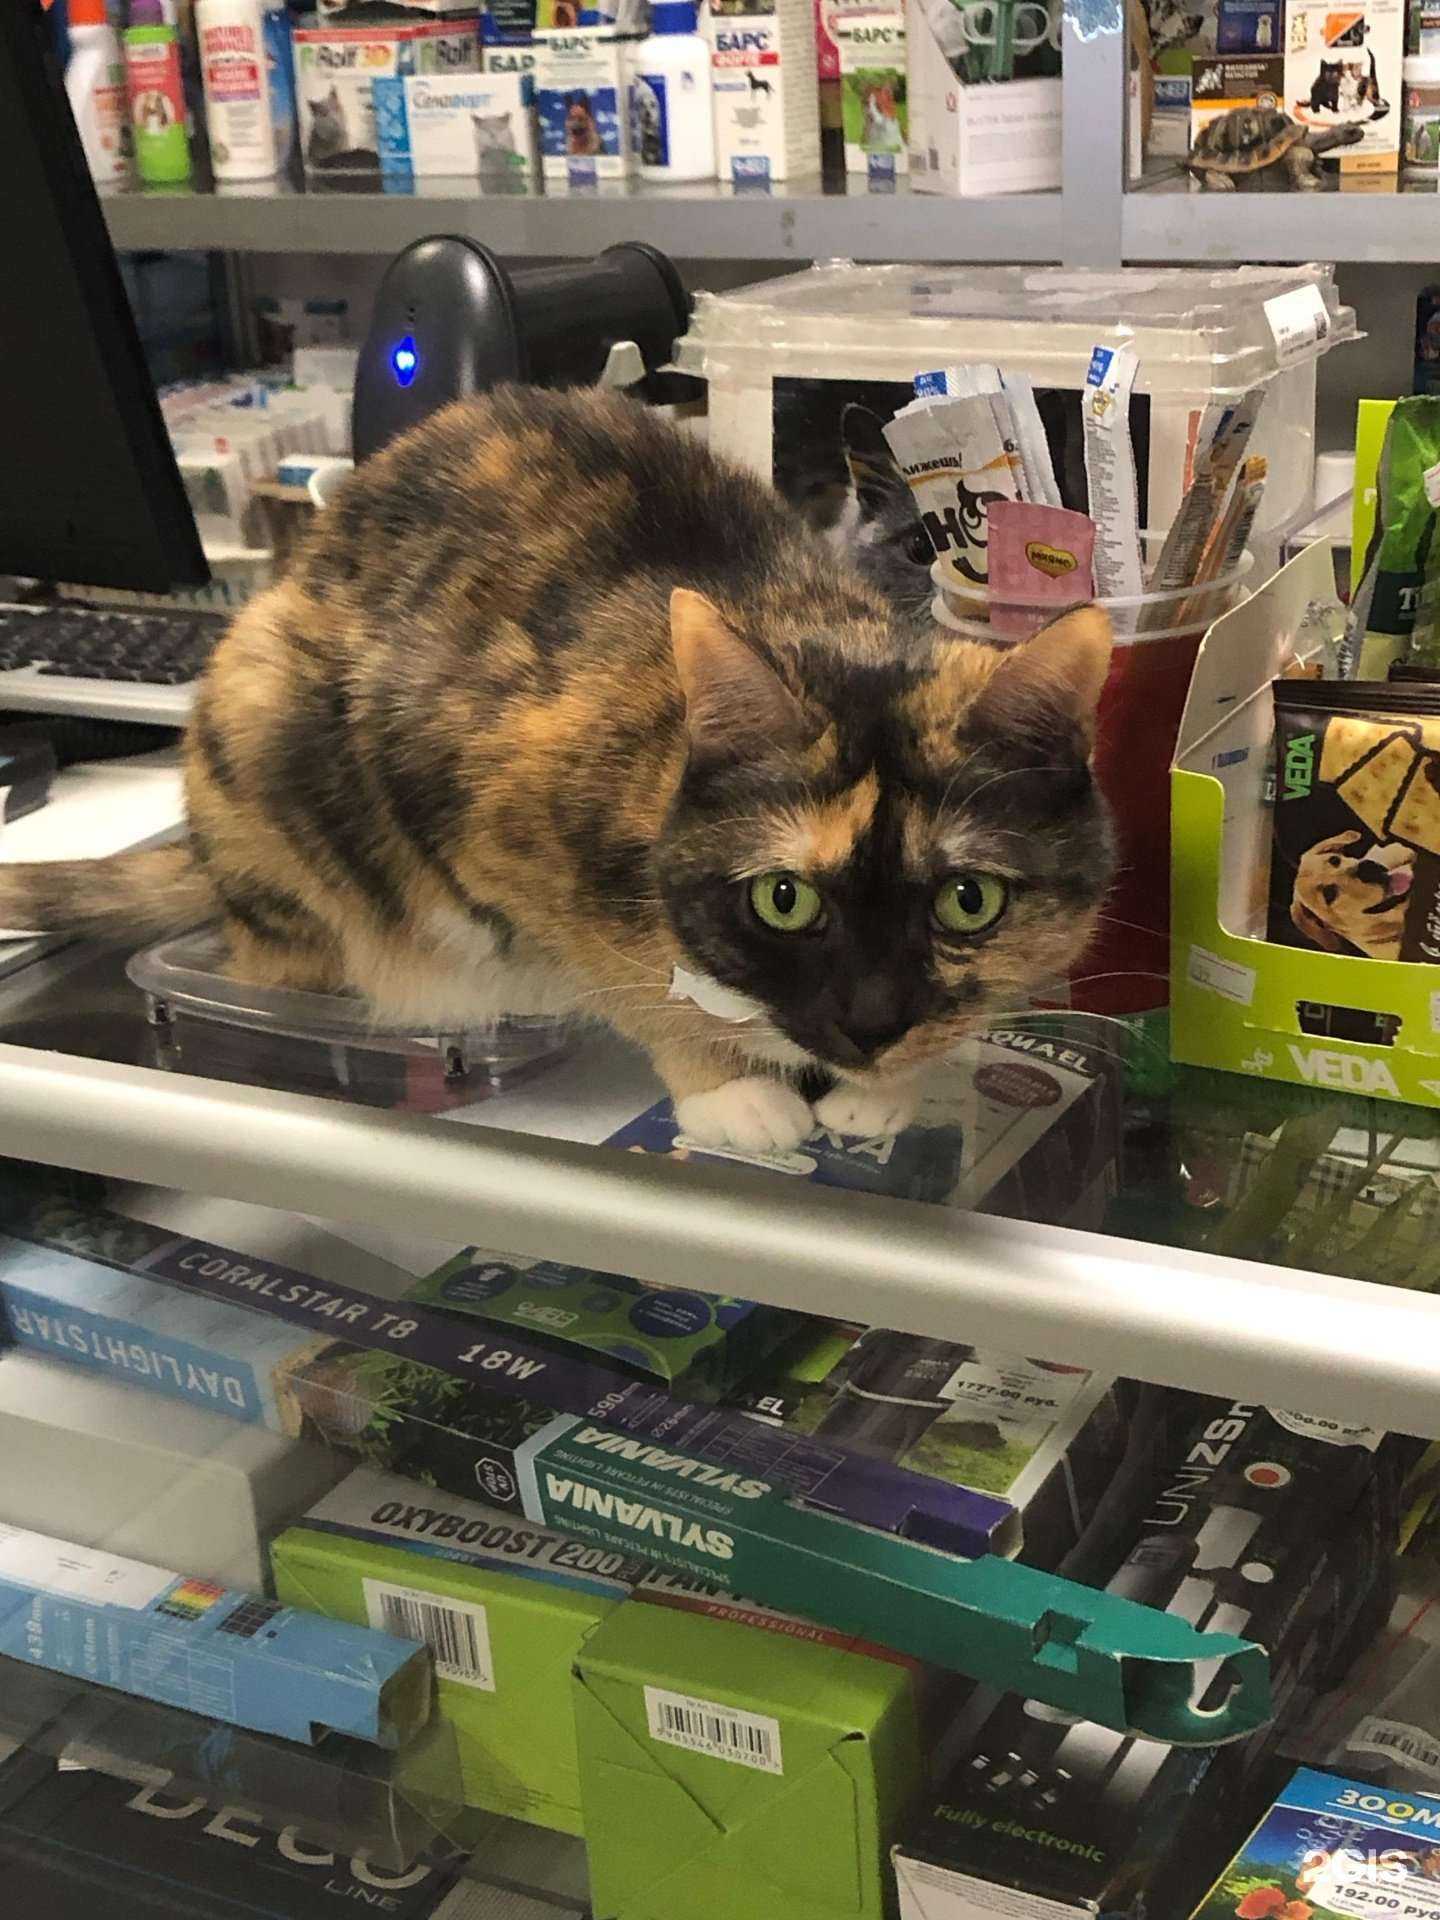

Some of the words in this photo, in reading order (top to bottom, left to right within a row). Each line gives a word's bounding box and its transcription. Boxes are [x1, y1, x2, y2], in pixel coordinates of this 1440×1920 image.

[549, 37, 591, 51] БАРС
[716, 31, 769, 51] БАРС
[1283, 734, 1317, 800] VEDA
[1286, 1044, 1402, 1097] VEDA
[178, 1252, 369, 1323] CORALSTAR
[370, 1311, 420, 1339] T8
[10, 1303, 247, 1409] DAYLIGHTSTAR
[457, 1343, 547, 1381] 18W
[572, 1426, 772, 1500] SYLVANIA
[370, 1502, 557, 1559] OXYBOOST
[553, 1541, 625, 1576] 200
[546, 1472, 735, 1560] SYLVANIA
[706, 1604, 827, 1642] PROFESSIONAL
[933, 1804, 988, 1829] Fully
[991, 1819, 1106, 1863] electronic
[324, 1878, 405, 1913] LINE
[1334, 1884, 1401, 1909] 192.00
